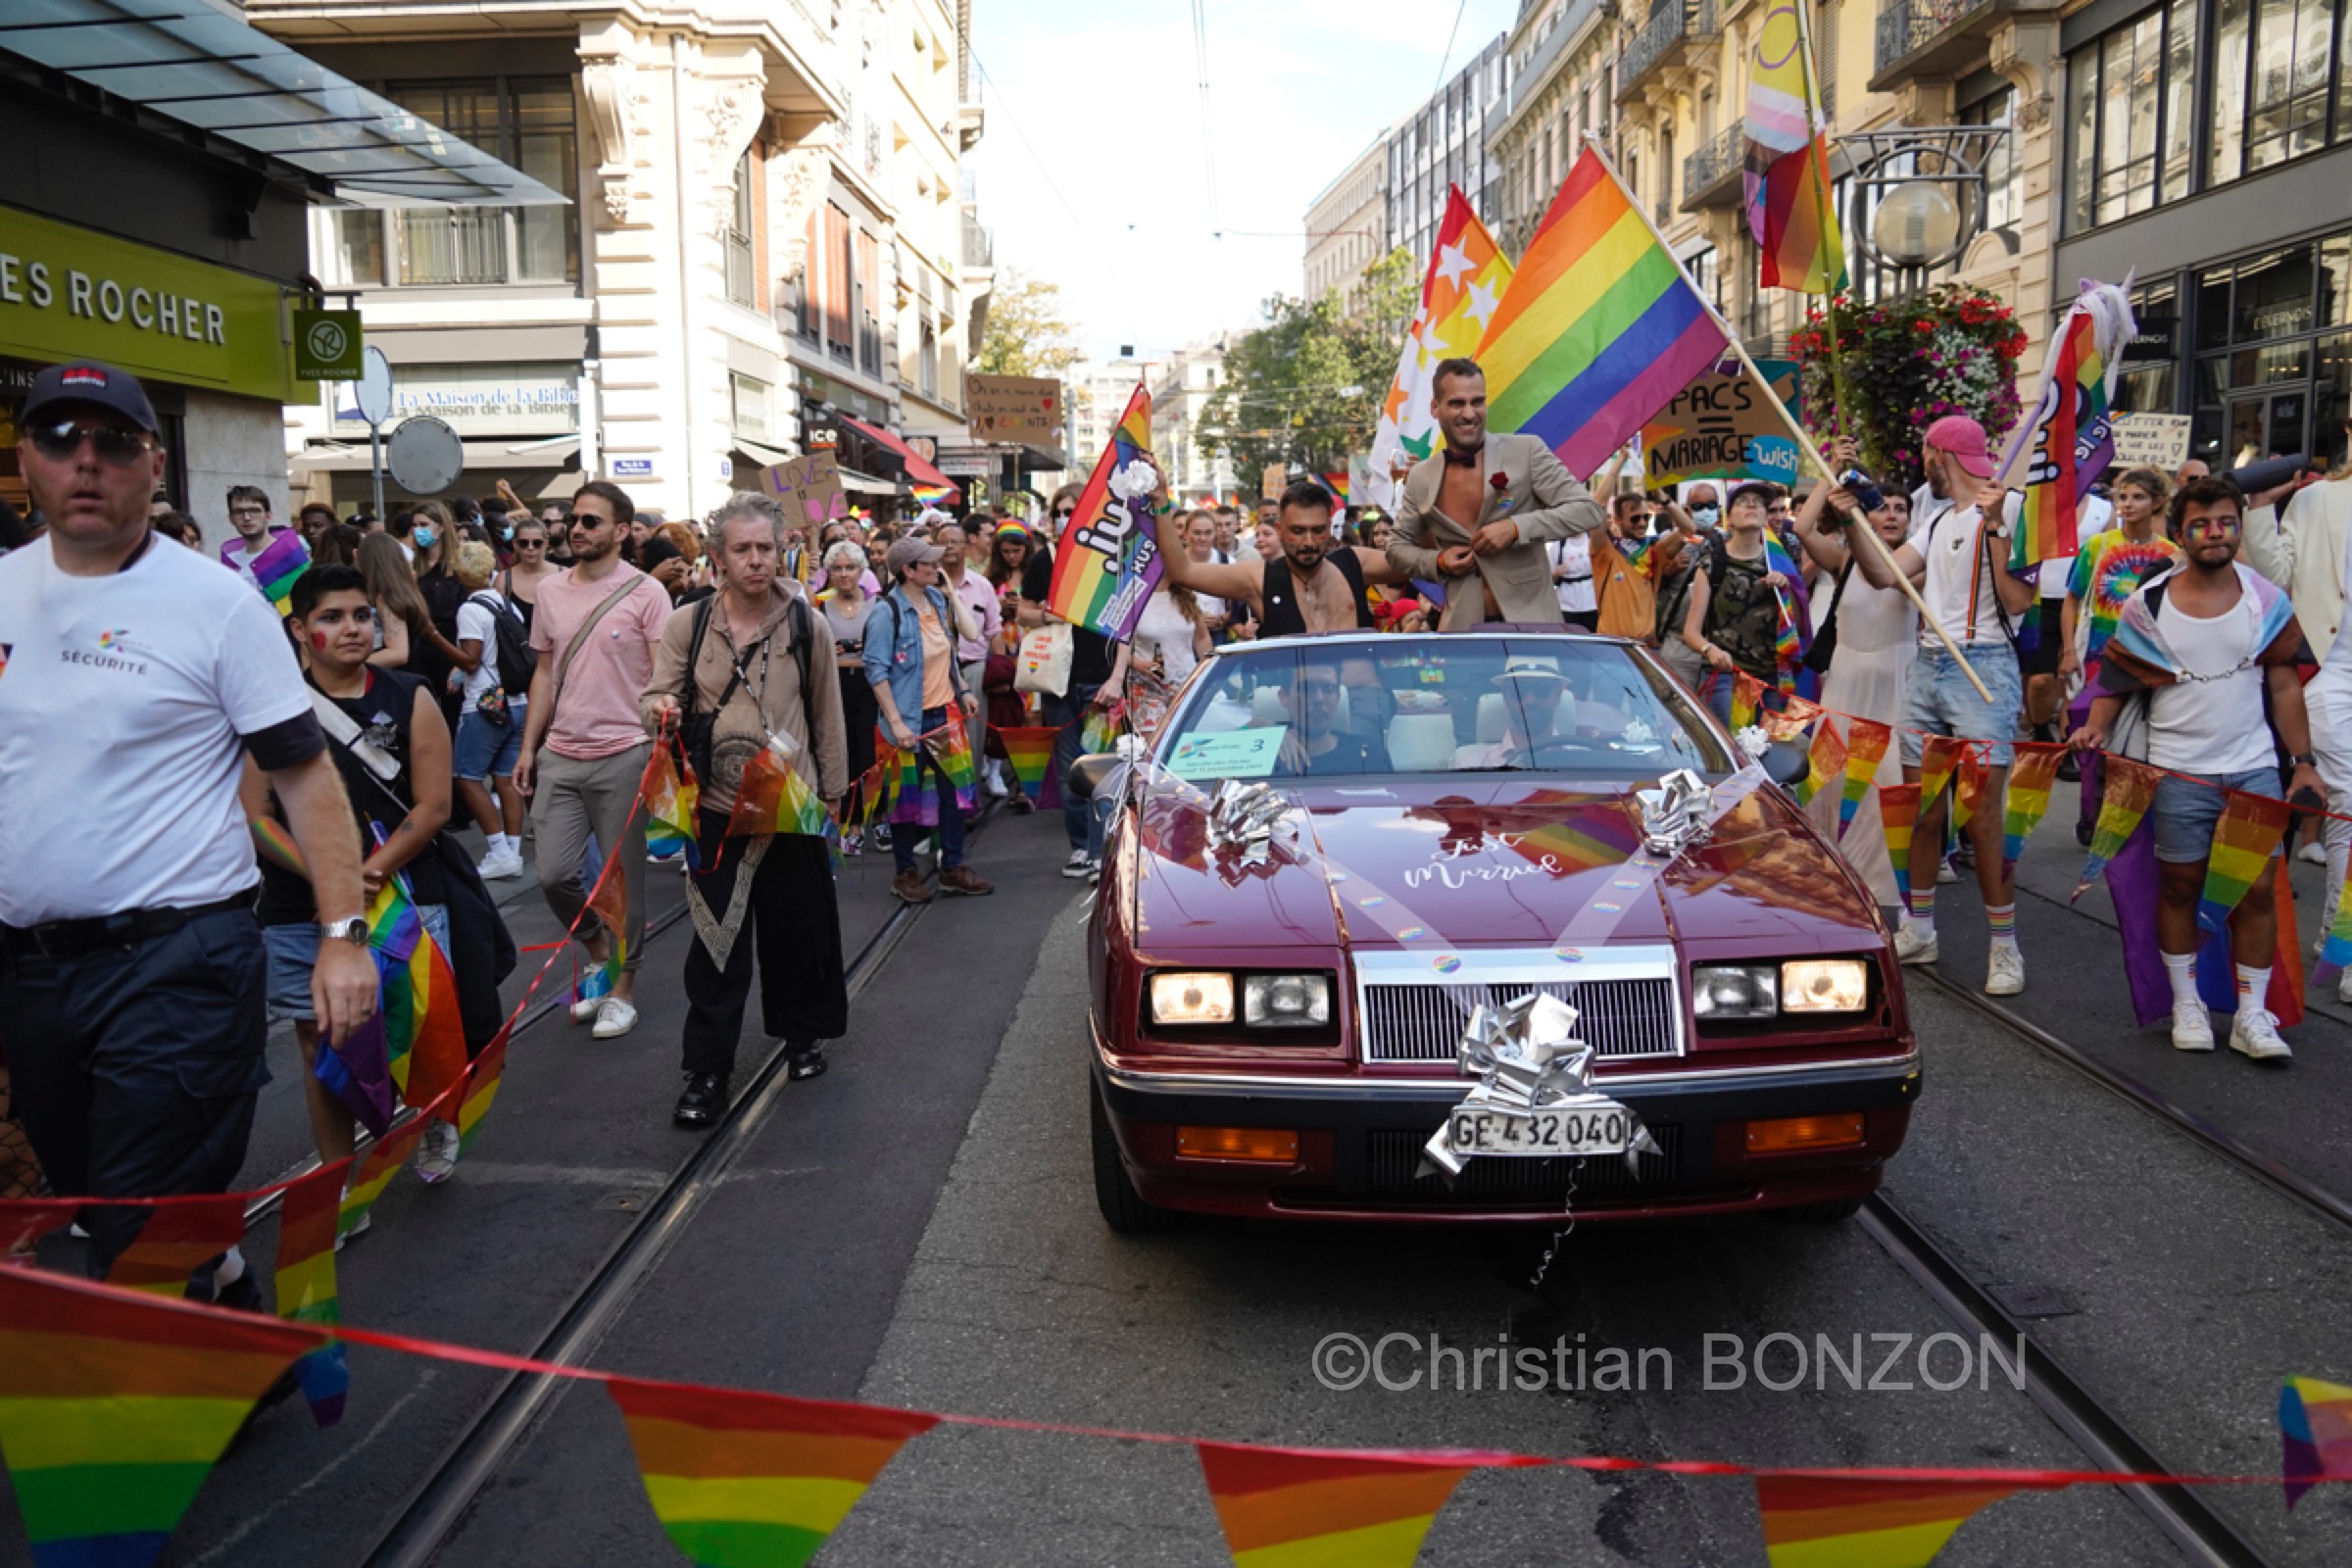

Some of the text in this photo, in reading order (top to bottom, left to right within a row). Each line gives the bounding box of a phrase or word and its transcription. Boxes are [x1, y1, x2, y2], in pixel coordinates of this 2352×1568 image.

[67, 269, 224, 345] ROCHER
[399, 384, 580, 407] La Maison de la Bible
[1670, 381, 1752, 416] PACS
[1650, 434, 1754, 475] MARIAGE
[771, 456, 825, 493] LOVE
[1250, 739, 1264, 753] 3
[1430, 830, 1529, 861] Just
[1403, 855, 1563, 888] Married
[1455, 1114, 1494, 1148] GE
